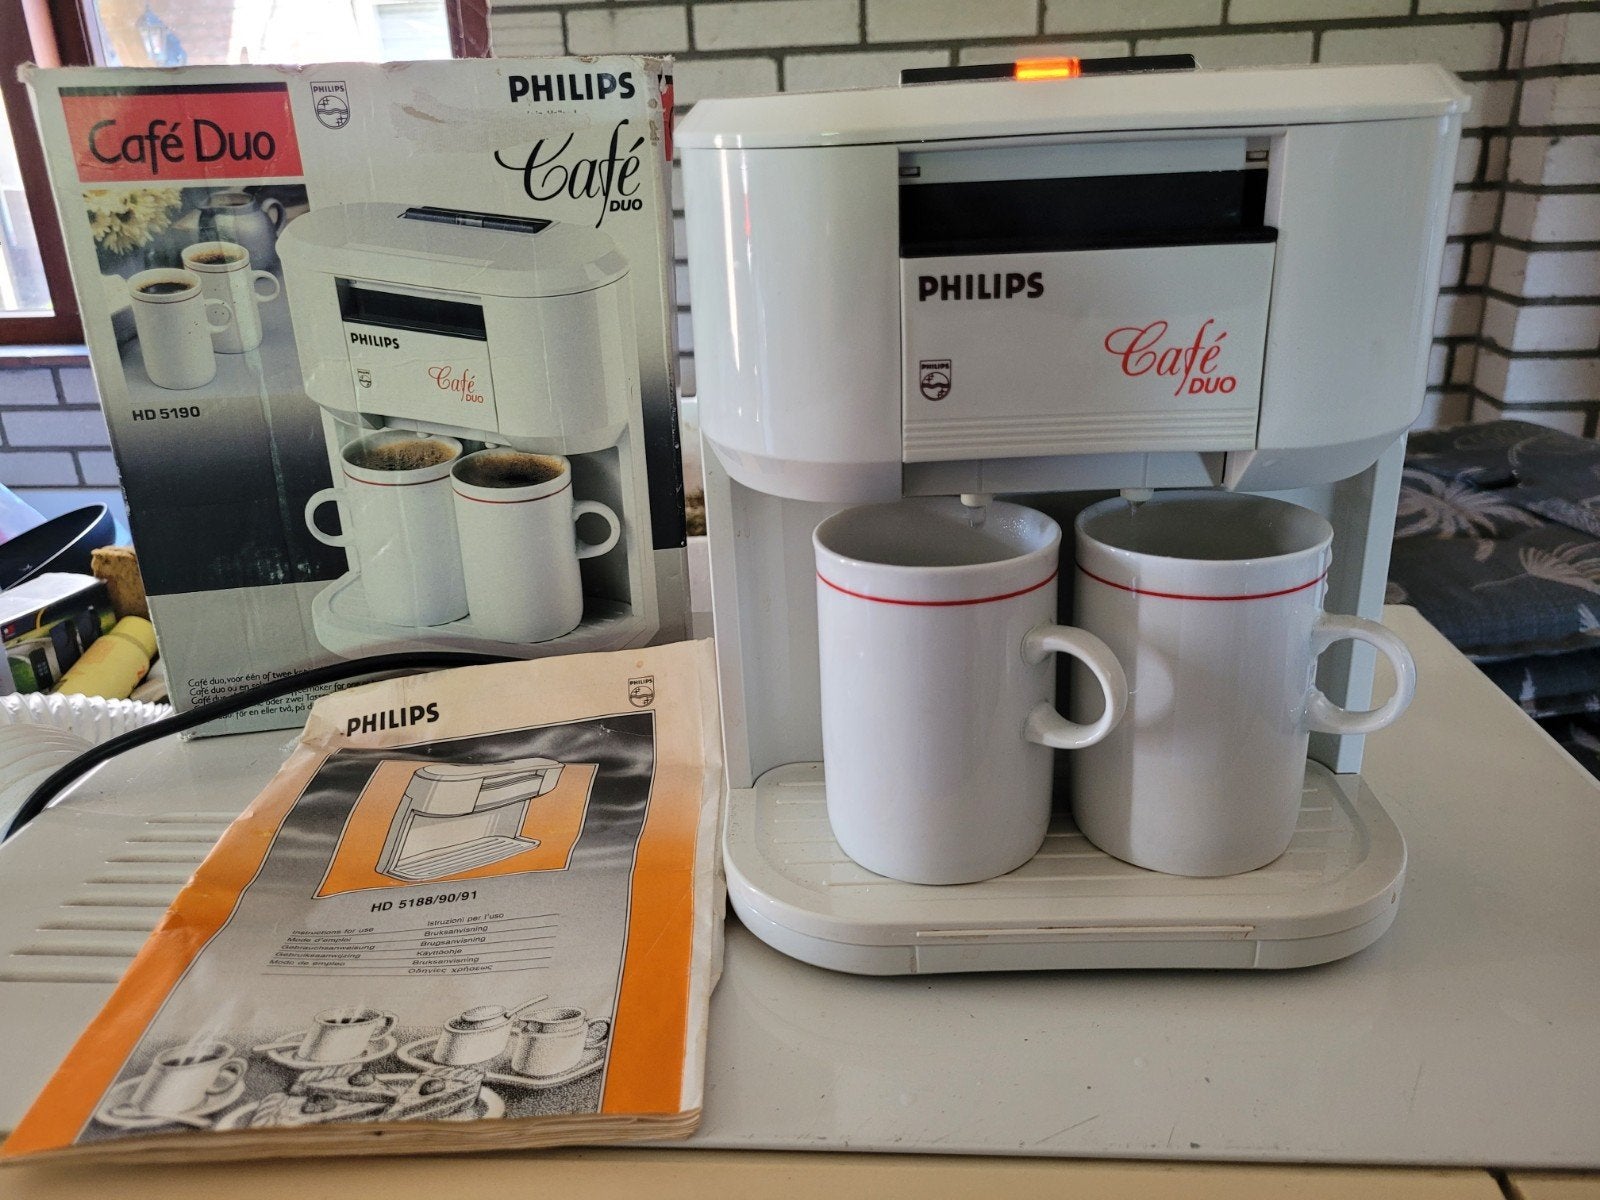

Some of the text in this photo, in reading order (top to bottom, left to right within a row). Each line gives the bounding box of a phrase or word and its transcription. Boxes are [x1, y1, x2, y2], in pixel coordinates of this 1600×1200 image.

[312, 84, 346, 93] PHILIPS
[508, 71, 636, 103] PHILIPS
[88, 118, 276, 175] Café Duo
[494, 118, 645, 229] Café
[609, 198, 643, 212] DUO
[918, 271, 1044, 302] PHILIPS
[350, 332, 400, 349] PHILIPS
[1104, 318, 1227, 396] Café
[921, 362, 950, 370] PHILIPS
[428, 365, 476, 402] Café
[1188, 376, 1236, 395] DUO
[465, 393, 484, 404] DUO
[132, 406, 201, 421] HD 5190
[188, 677, 208, 689] Café
[262, 671, 272, 681] of
[630, 678, 653, 686] PHILIPS
[189, 686, 209, 697] Café
[210, 686, 226, 694] duo
[285, 694, 304, 704] zwei
[249, 708, 259, 716] en
[260, 706, 277, 714] eller
[346, 702, 440, 737] PHILIPS
[370, 890, 477, 913] HD 5188/90/91
[427, 912, 504, 927] Istruzioni per l'uso
[424, 925, 489, 937] Bruksanvisning
[420, 936, 486, 947] Brugsanvisning
[411, 956, 480, 966] Bruksanvisning
